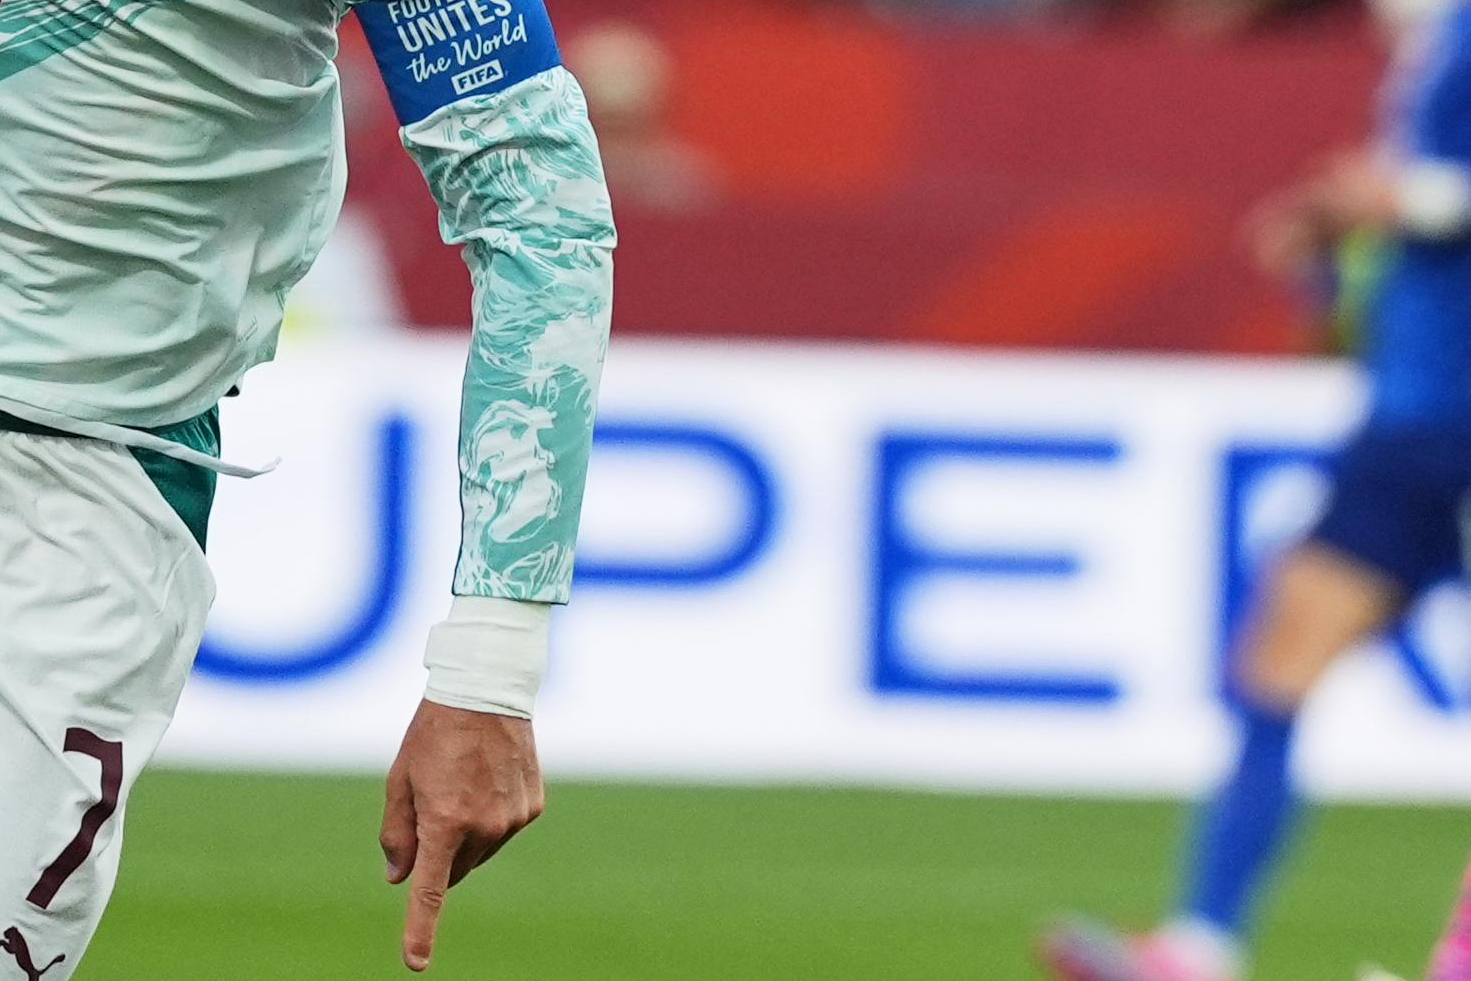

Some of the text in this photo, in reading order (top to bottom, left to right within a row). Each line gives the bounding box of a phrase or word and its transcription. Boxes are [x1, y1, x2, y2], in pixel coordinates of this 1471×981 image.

[406, 13, 528, 83] the World
[455, 63, 501, 91] FIFA
[25, 726, 123, 910] 7
